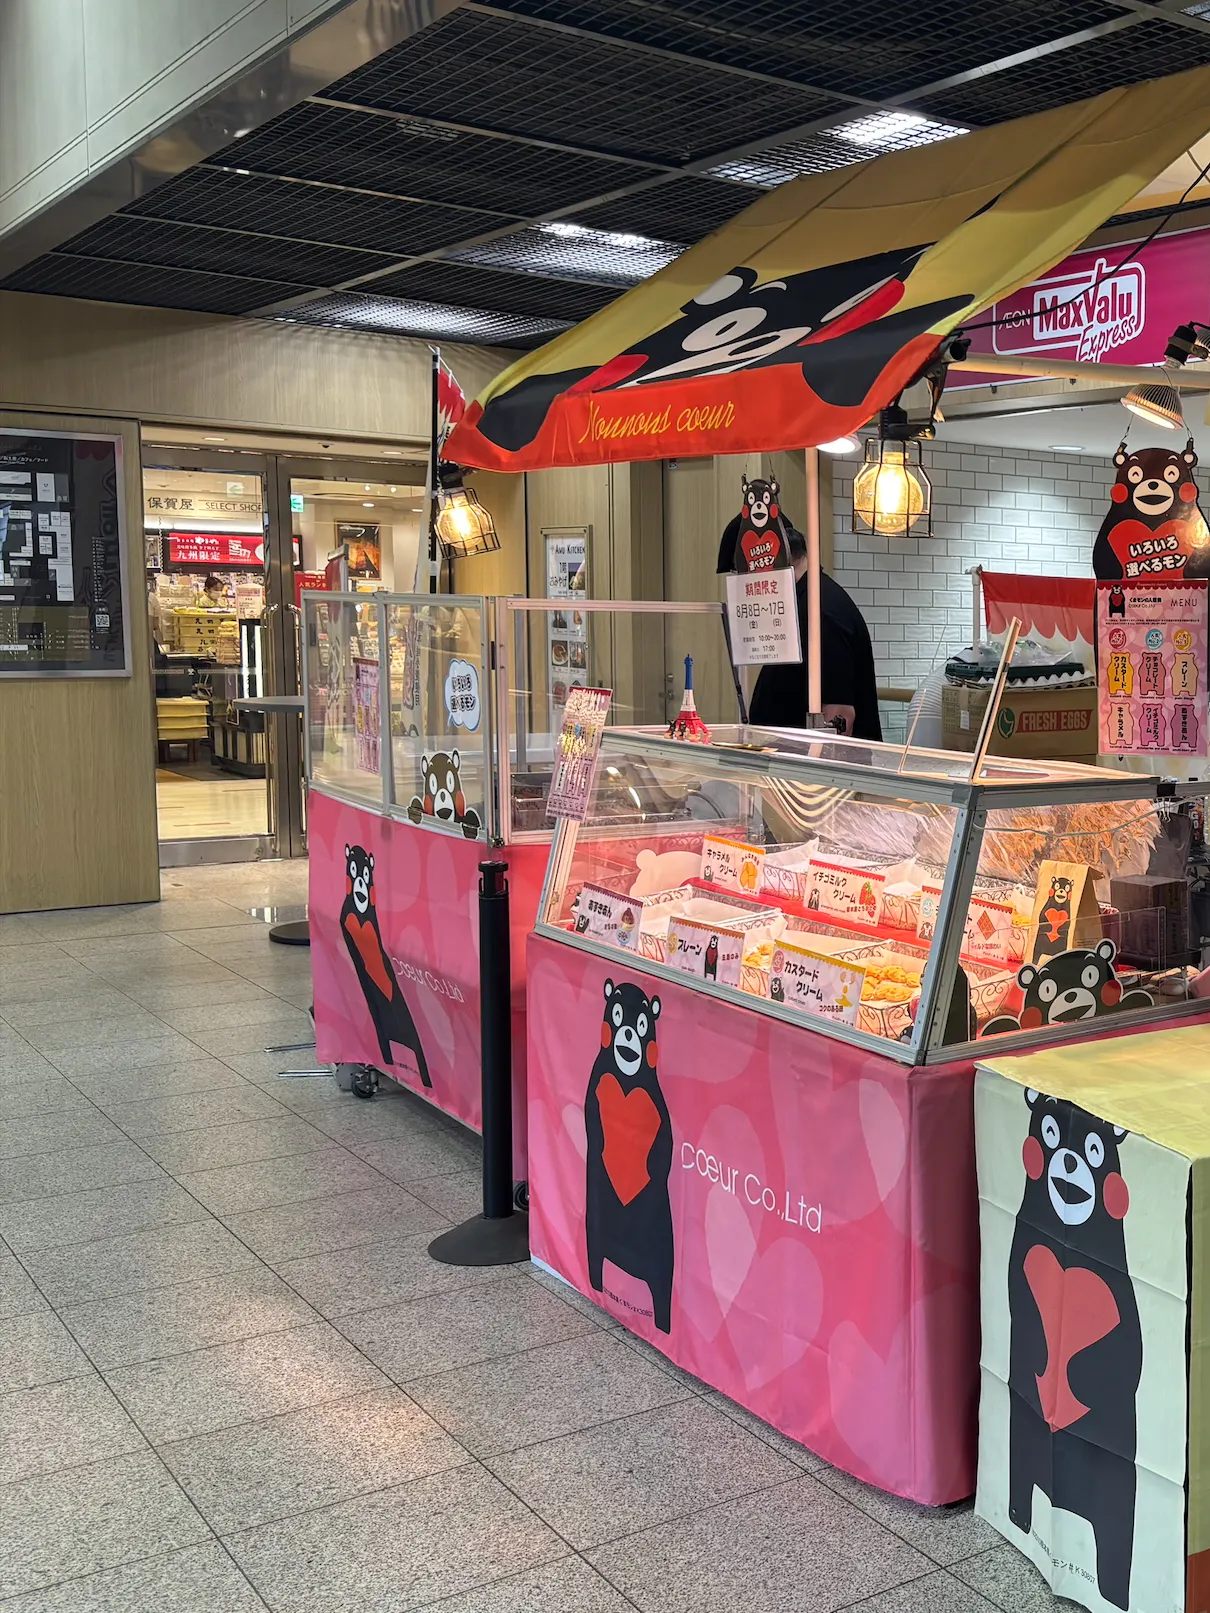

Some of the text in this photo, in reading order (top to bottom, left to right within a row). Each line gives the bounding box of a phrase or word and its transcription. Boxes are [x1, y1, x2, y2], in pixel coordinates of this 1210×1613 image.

[1039, 262, 1133, 333] MaxValu
[1079, 315, 1137, 362] Express
[205, 501, 236, 511] SELECT
[1128, 534, 1179, 558] いろいろ
[1125, 553, 1188, 578] 選べるモン
[745, 580, 779, 597] 期間限定
[1170, 599, 1198, 607] MENU
[1022, 711, 1087, 731] FRESH EGGS
[813, 871, 847, 887] イチゴミルク
[833, 889, 856, 904] クリーム
[785, 961, 819, 982] カスタード
[796, 981, 823, 1001] クリーム
